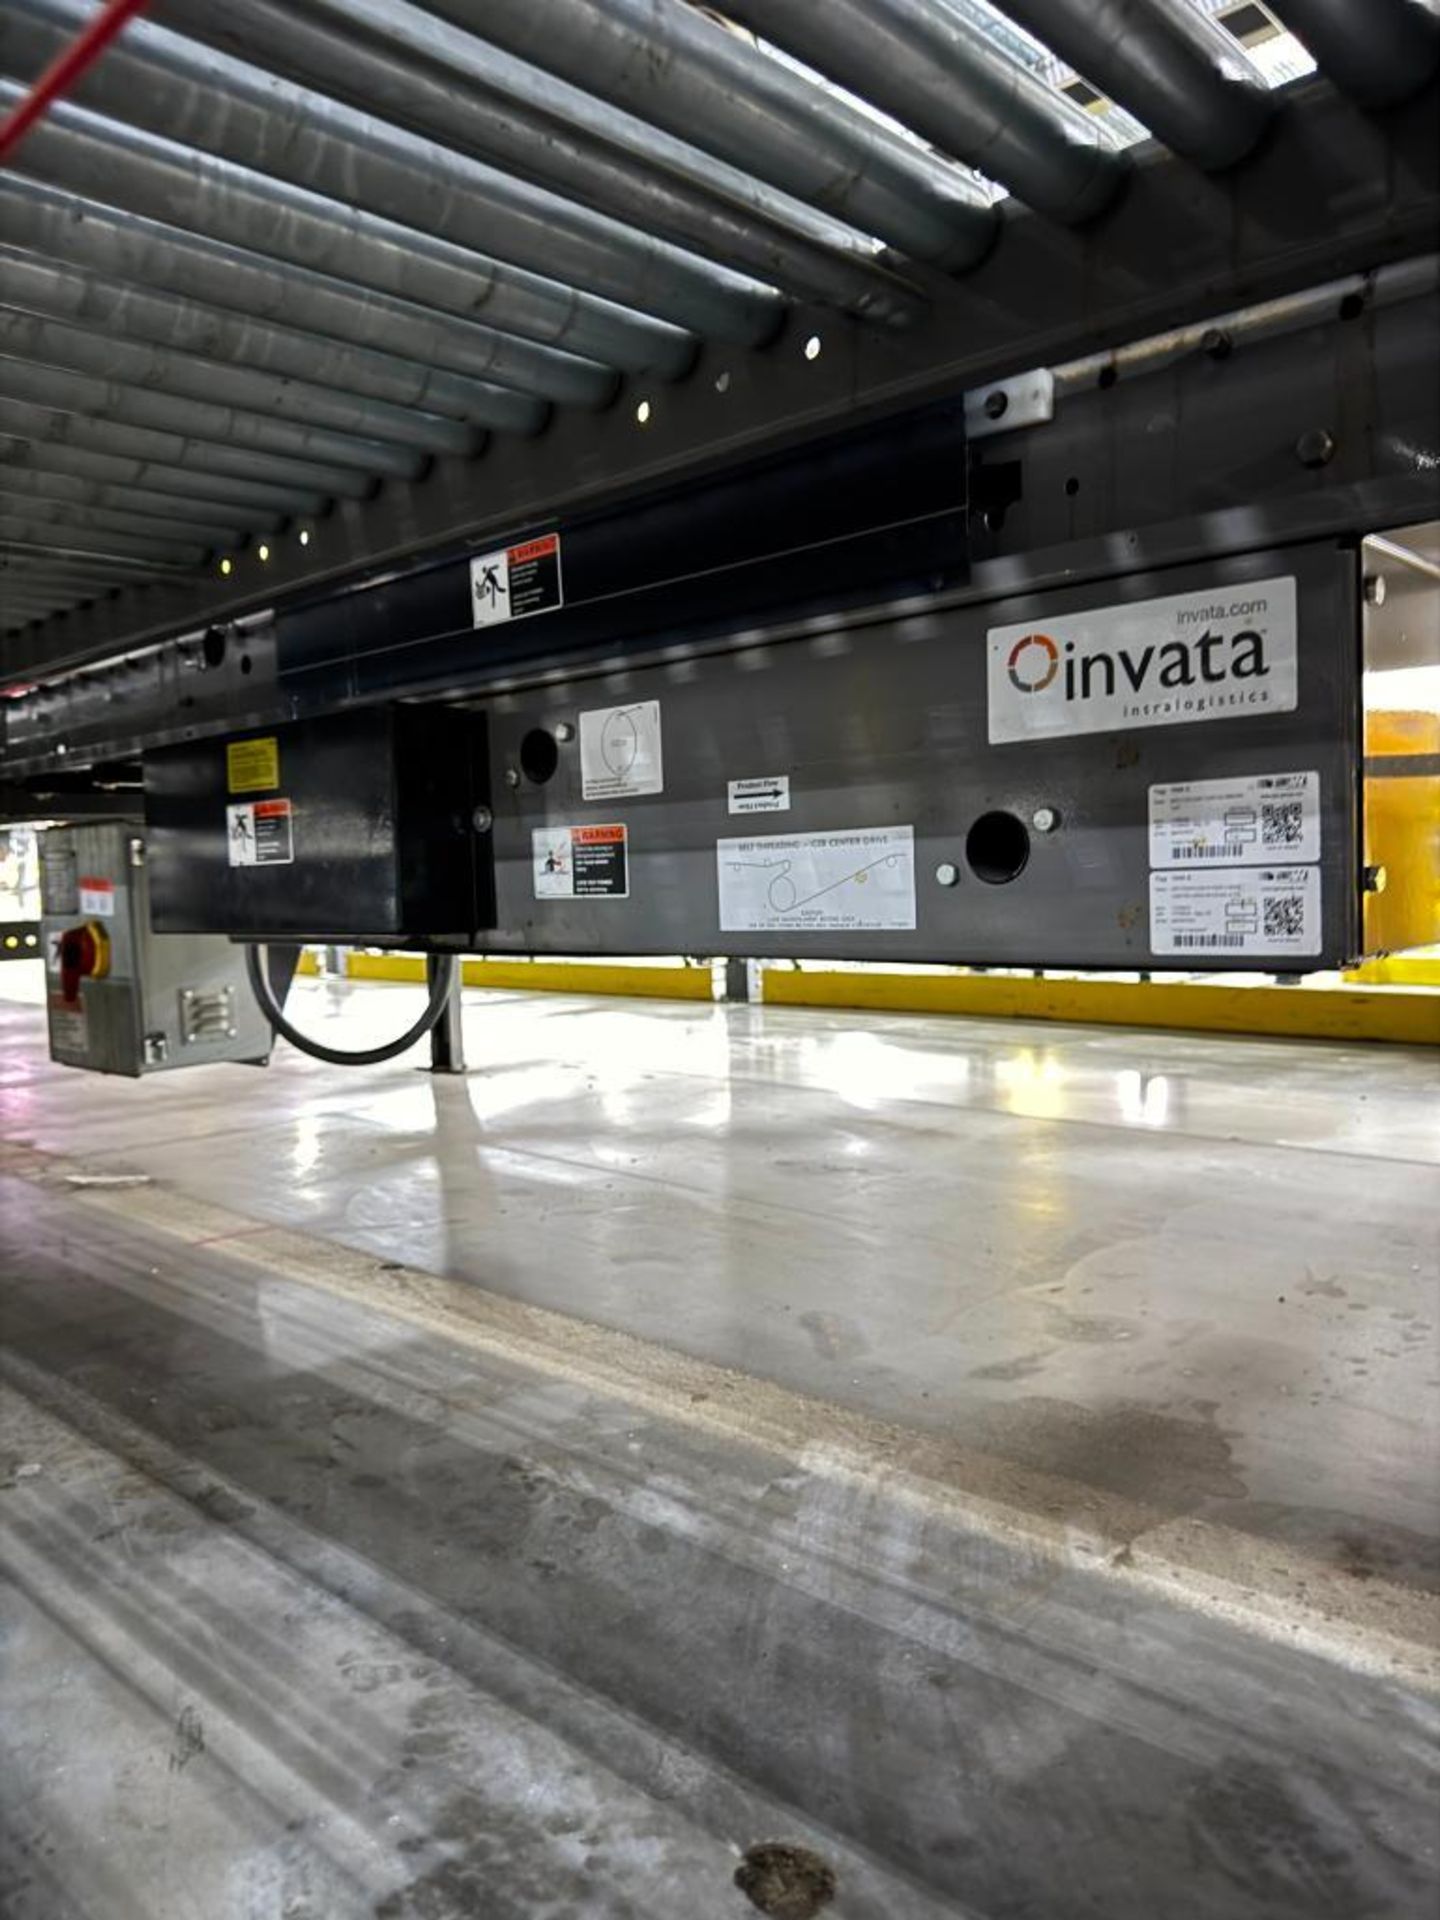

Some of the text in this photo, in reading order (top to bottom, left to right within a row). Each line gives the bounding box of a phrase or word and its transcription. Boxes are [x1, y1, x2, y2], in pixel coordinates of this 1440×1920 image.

[1176, 599, 1268, 625] invata.com
[1065, 629, 1270, 701] invata
[1123, 690, 1269, 718] intralogistics
[737, 780, 779, 790] Product Flow
[582, 827, 624, 841] WARNING
[829, 836, 861, 847] CENTER
[862, 834, 889, 845] DRIVE
